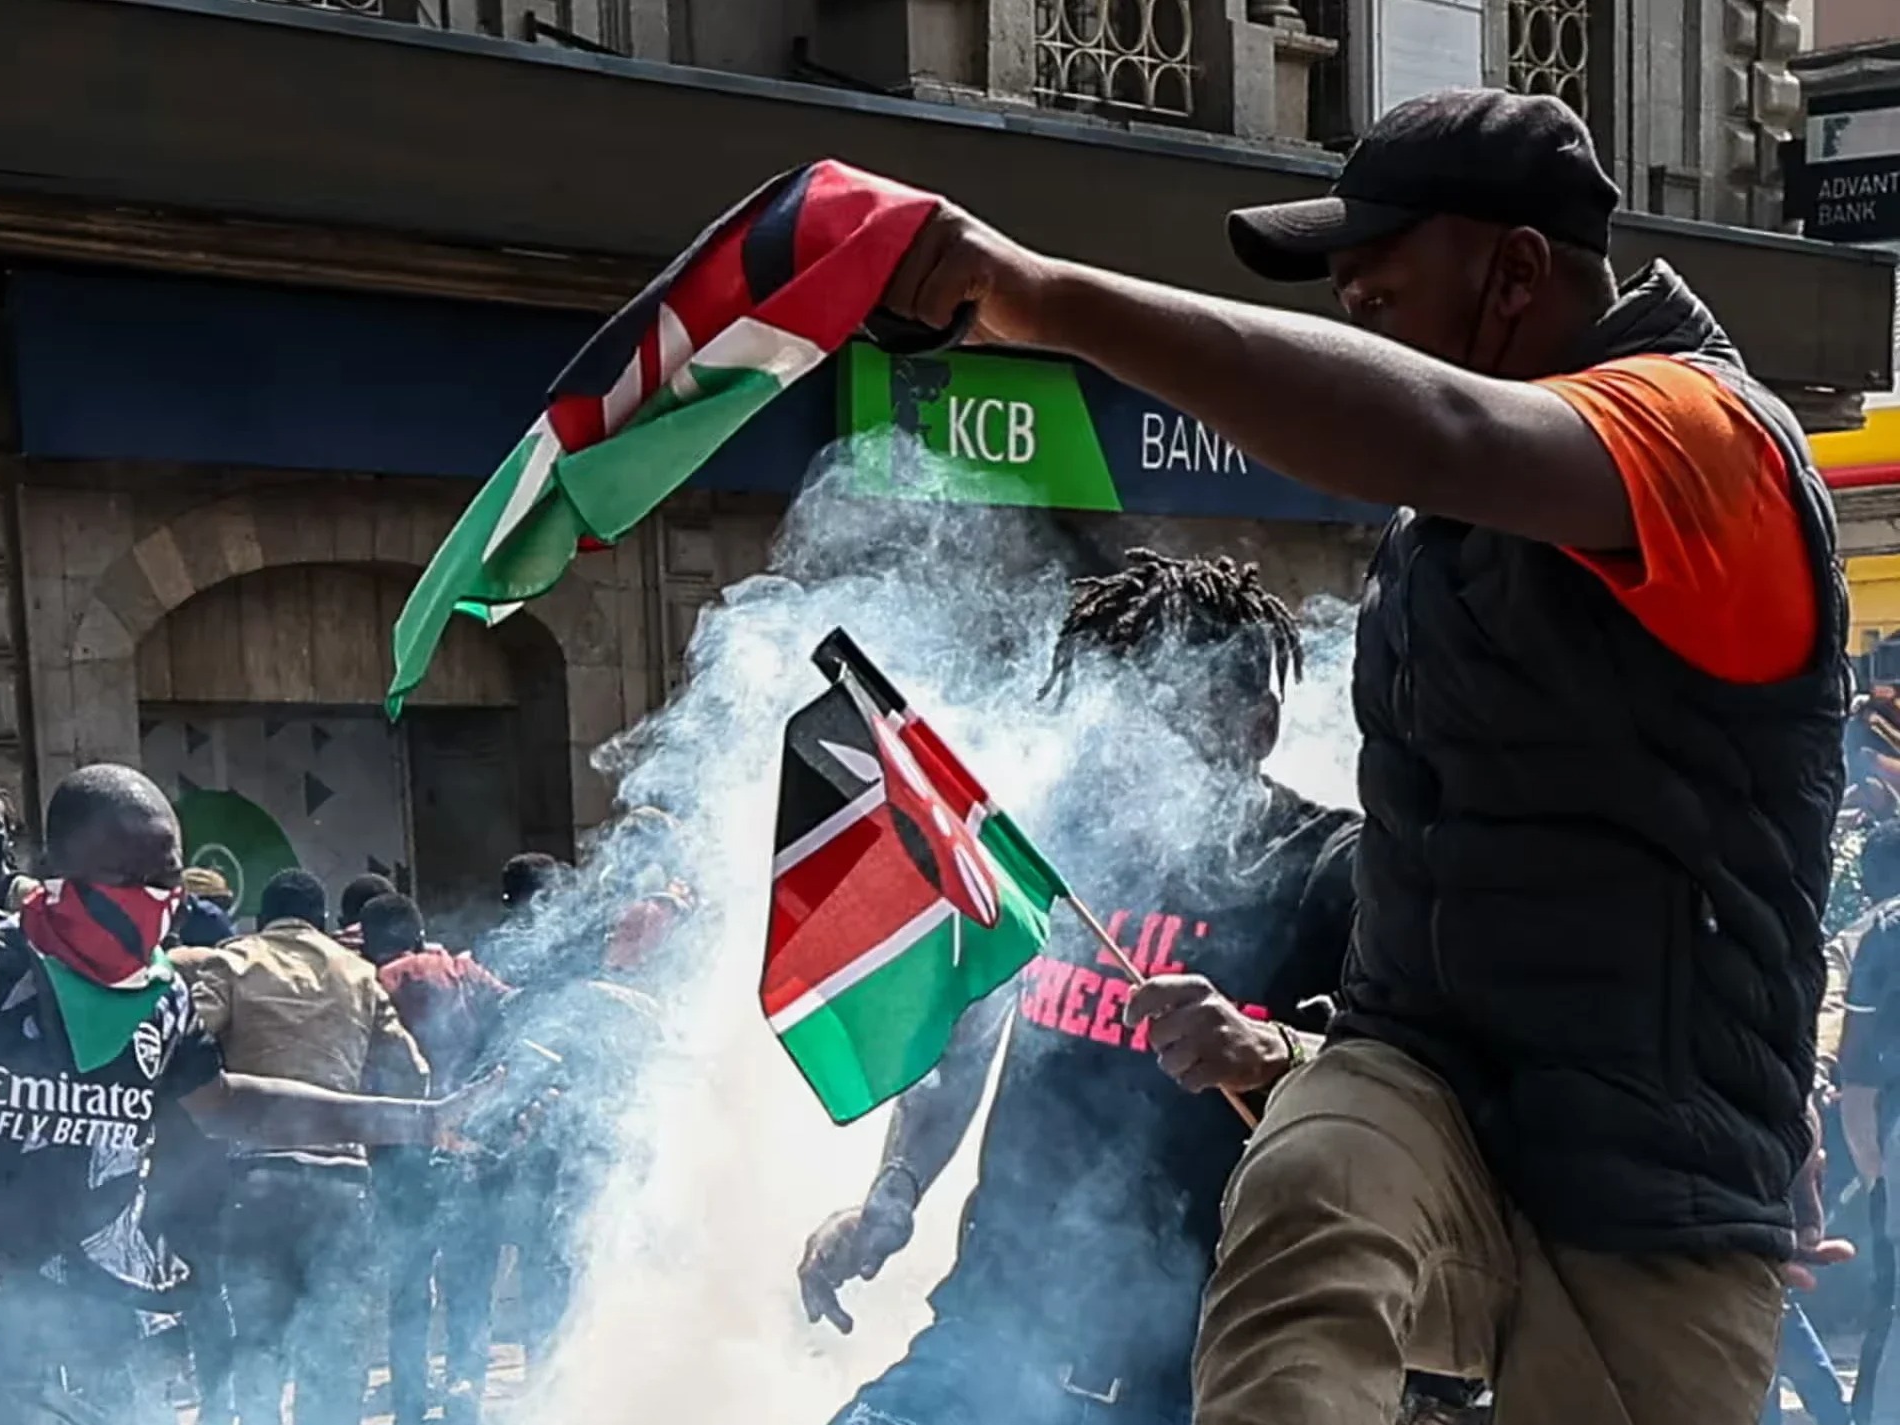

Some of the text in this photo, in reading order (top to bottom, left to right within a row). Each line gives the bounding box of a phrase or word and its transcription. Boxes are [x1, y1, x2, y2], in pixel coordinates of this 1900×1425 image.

[1819, 201, 1877, 225] BANK
[949, 396, 1036, 463] KCB
[52, 1117, 140, 1151] BETTER
